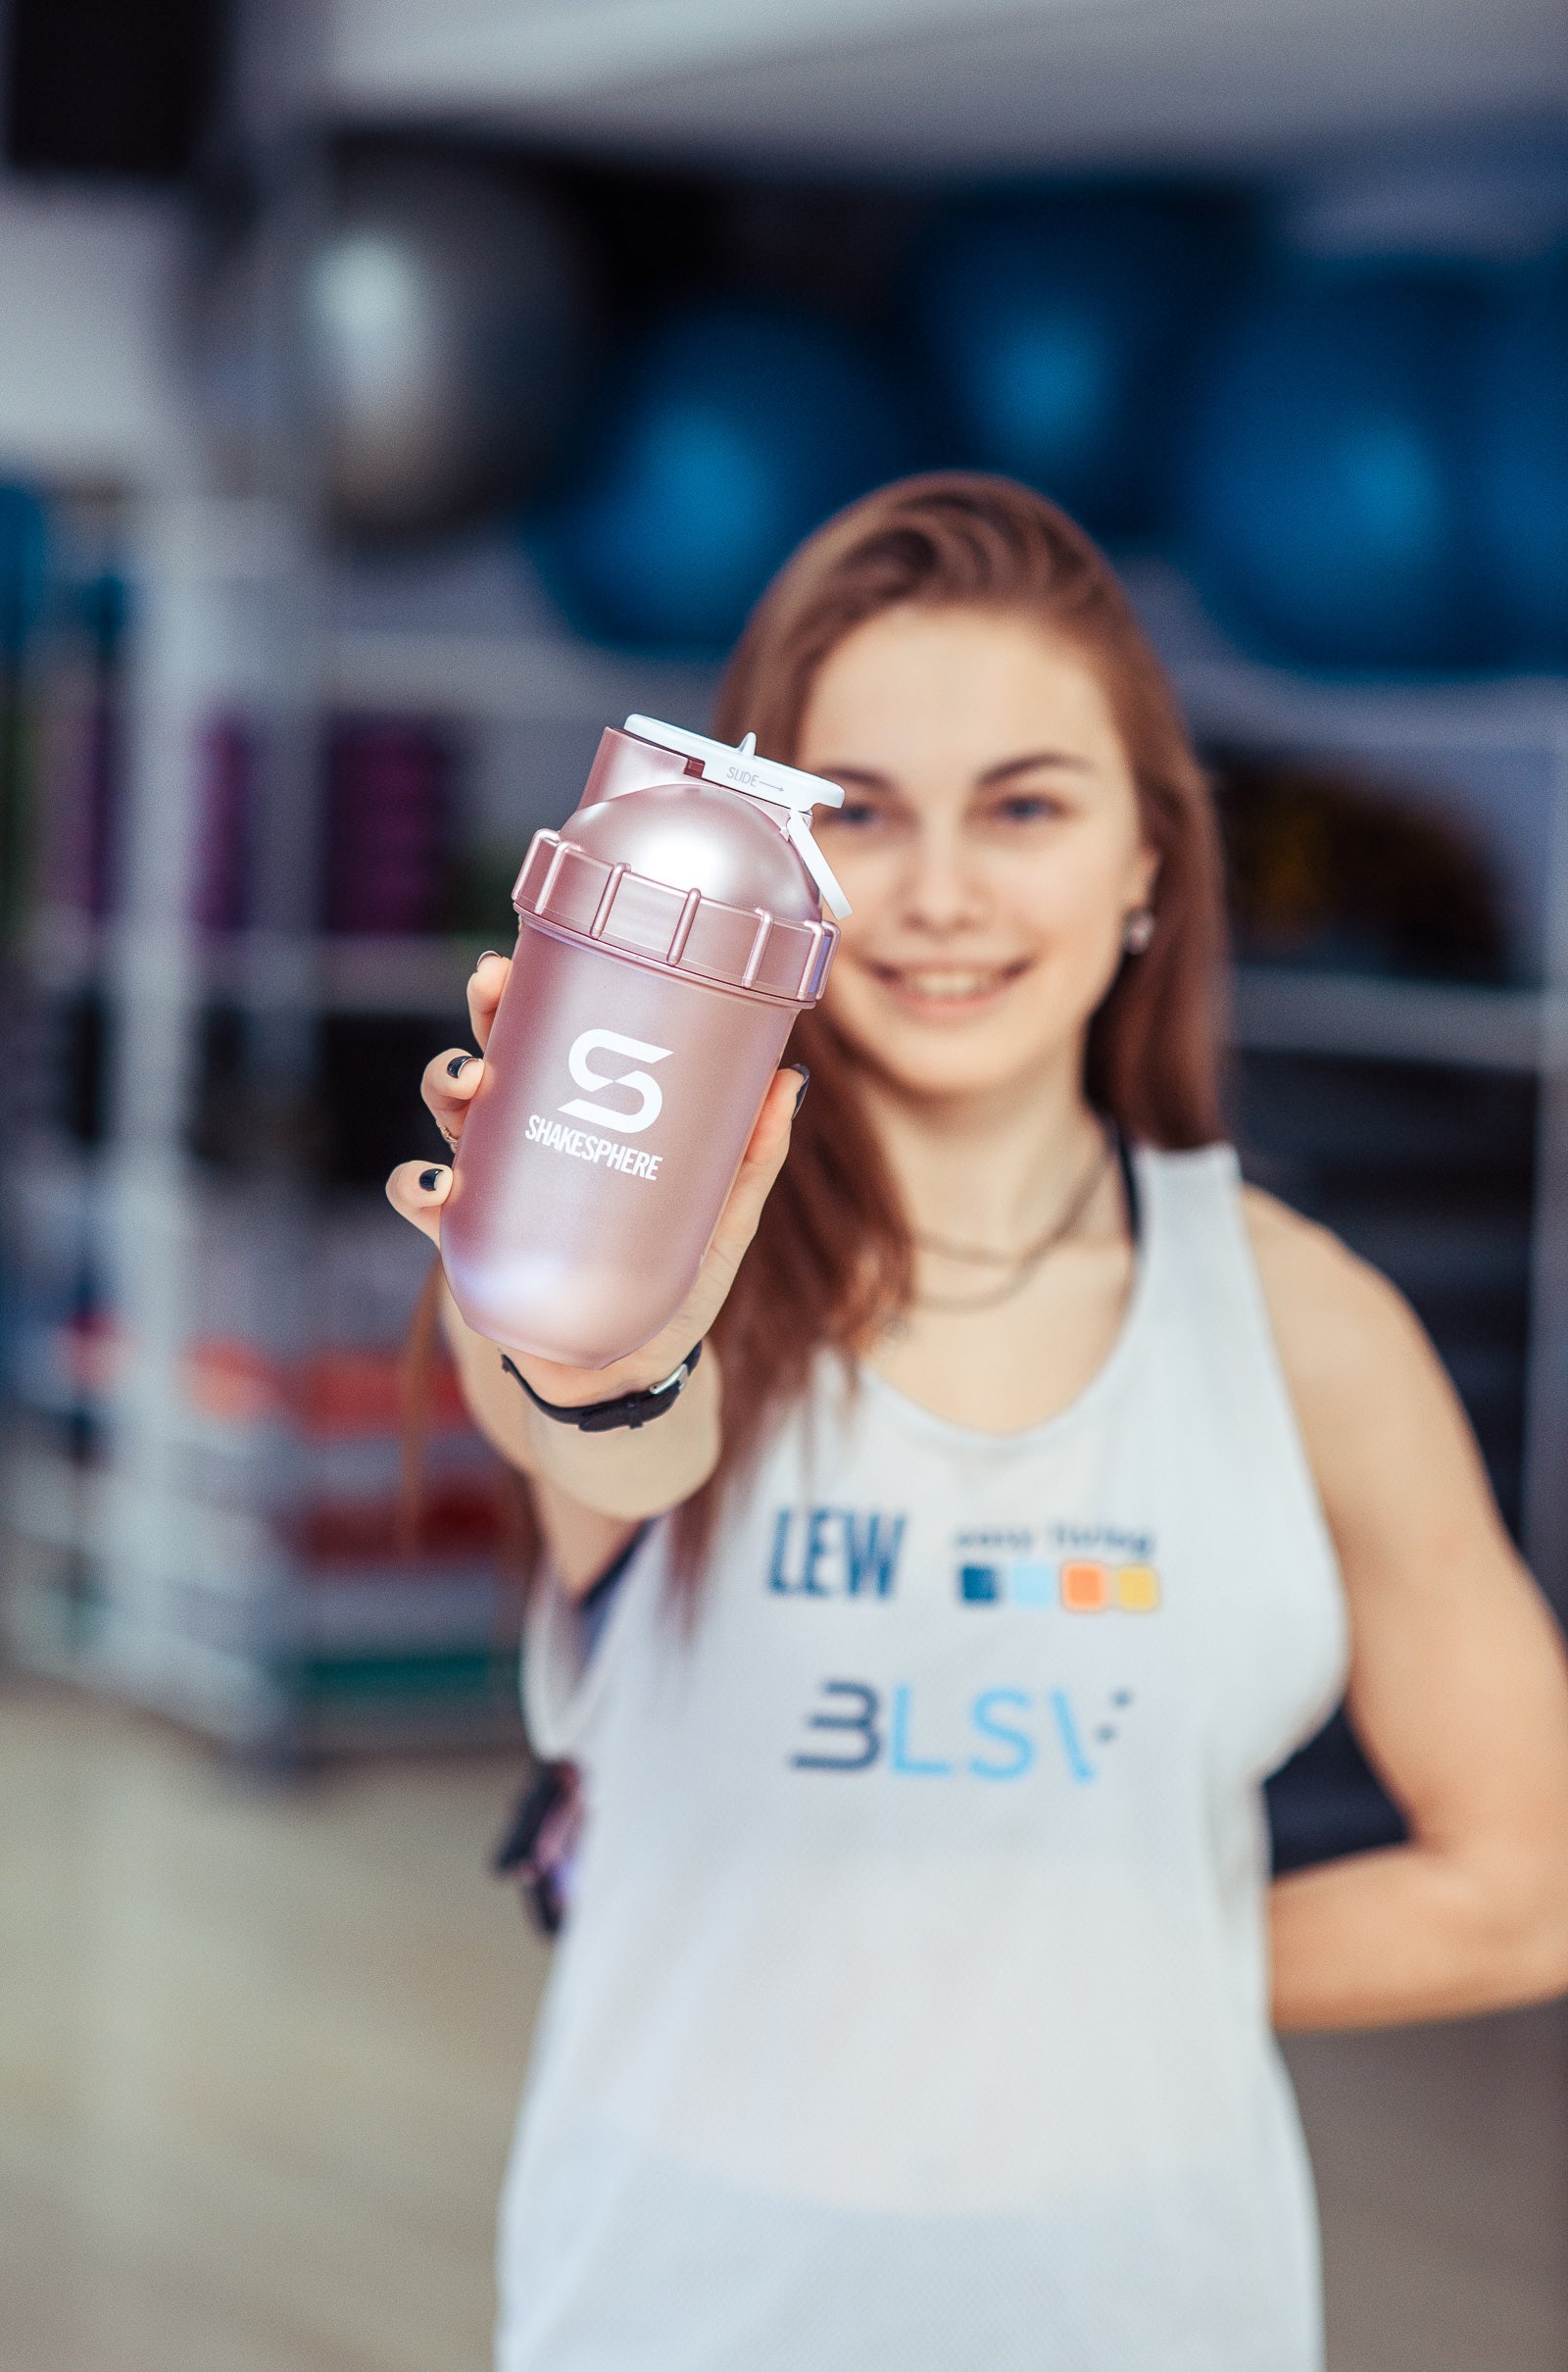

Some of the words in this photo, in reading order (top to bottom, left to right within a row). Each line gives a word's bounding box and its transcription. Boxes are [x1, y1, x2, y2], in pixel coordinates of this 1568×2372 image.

[726, 766, 760, 787] SLIDE
[557, 1028, 674, 1134] S
[524, 1114, 663, 1181] SHAKESPHERE
[767, 1506, 906, 1602] LEW
